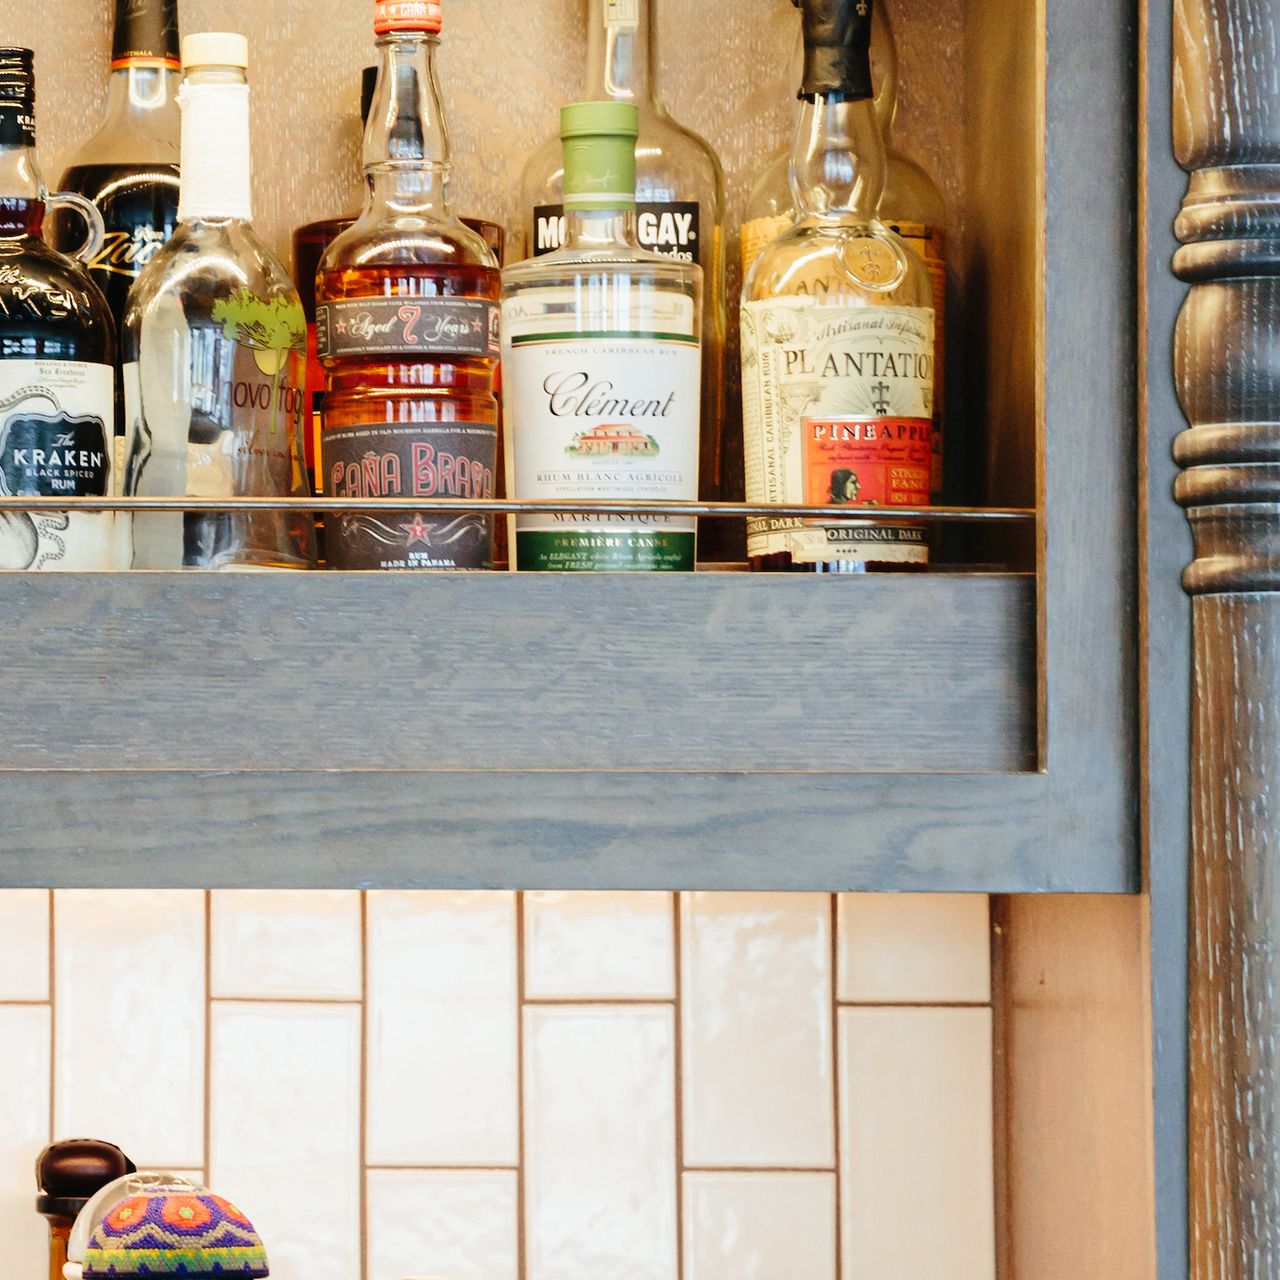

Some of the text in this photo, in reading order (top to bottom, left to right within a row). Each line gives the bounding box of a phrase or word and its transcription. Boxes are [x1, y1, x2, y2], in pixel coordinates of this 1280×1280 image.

[637, 212, 693, 246] GAY
[87, 231, 164, 278] Zac
[348, 305, 470, 345] Aged 7 Years
[816, 319, 882, 341] Artisanal
[543, 371, 676, 419] Clément
[763, 381, 774, 443] CARIBBEAN
[52, 430, 75, 447] The
[13, 448, 102, 468] KRAKEN
[25, 469, 95, 478] BLACK SPICED
[330, 442, 494, 498] CAÑA BRAVA
[536, 472, 684, 483] RHUM BLANC AGRICOLE
[768, 446, 777, 503] RTISANAL
[51, 478, 76, 490] RUM
[552, 513, 672, 525] MARTINIQUE
[770, 517, 805, 530] DARK
[554, 535, 669, 548] PREMIÈRE CANNE
[827, 528, 895, 540] ORIGINAL
[380, 558, 456, 568] MADE IN PANAMA
[408, 551, 429, 560] RUM
[564, 561, 594, 569] FRESH
